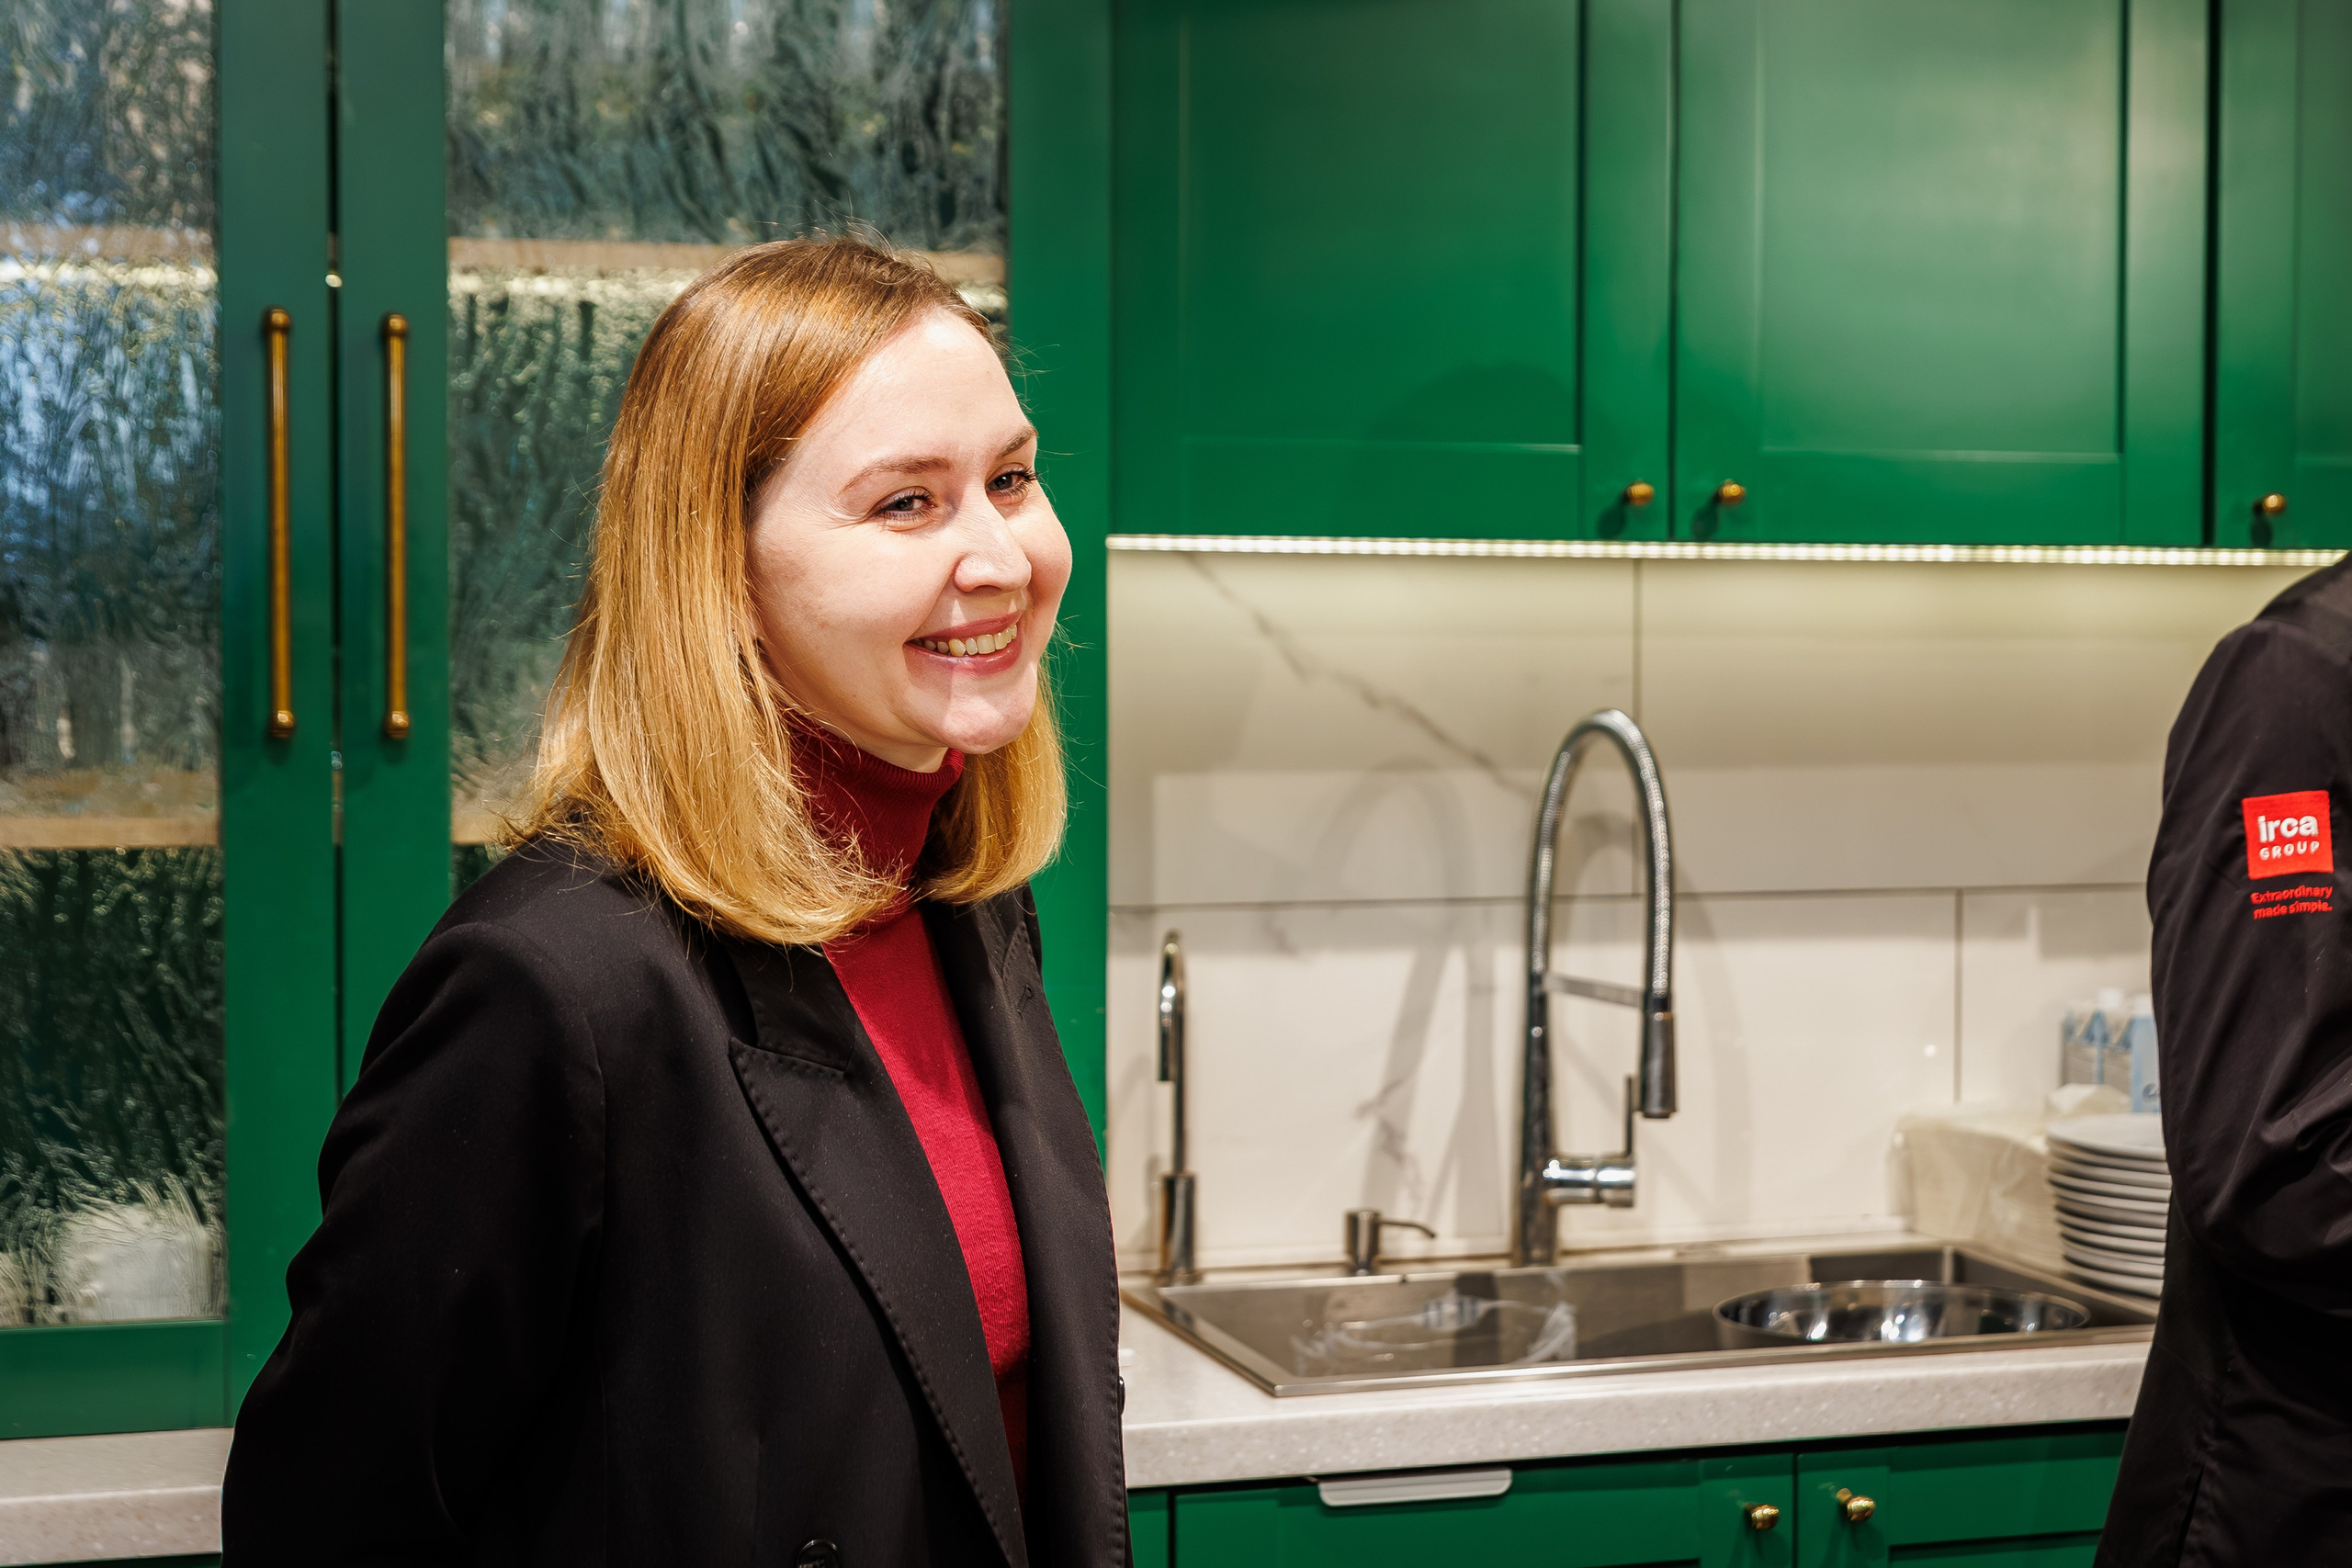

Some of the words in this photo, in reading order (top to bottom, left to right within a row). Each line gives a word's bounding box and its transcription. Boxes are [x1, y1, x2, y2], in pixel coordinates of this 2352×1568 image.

[2257, 815, 2319, 843] irca
[2259, 840, 2320, 861] GROUP
[2250, 885, 2333, 905] Extraordinary
[2253, 904, 2288, 920] made
[2289, 899, 2333, 915] simple.
